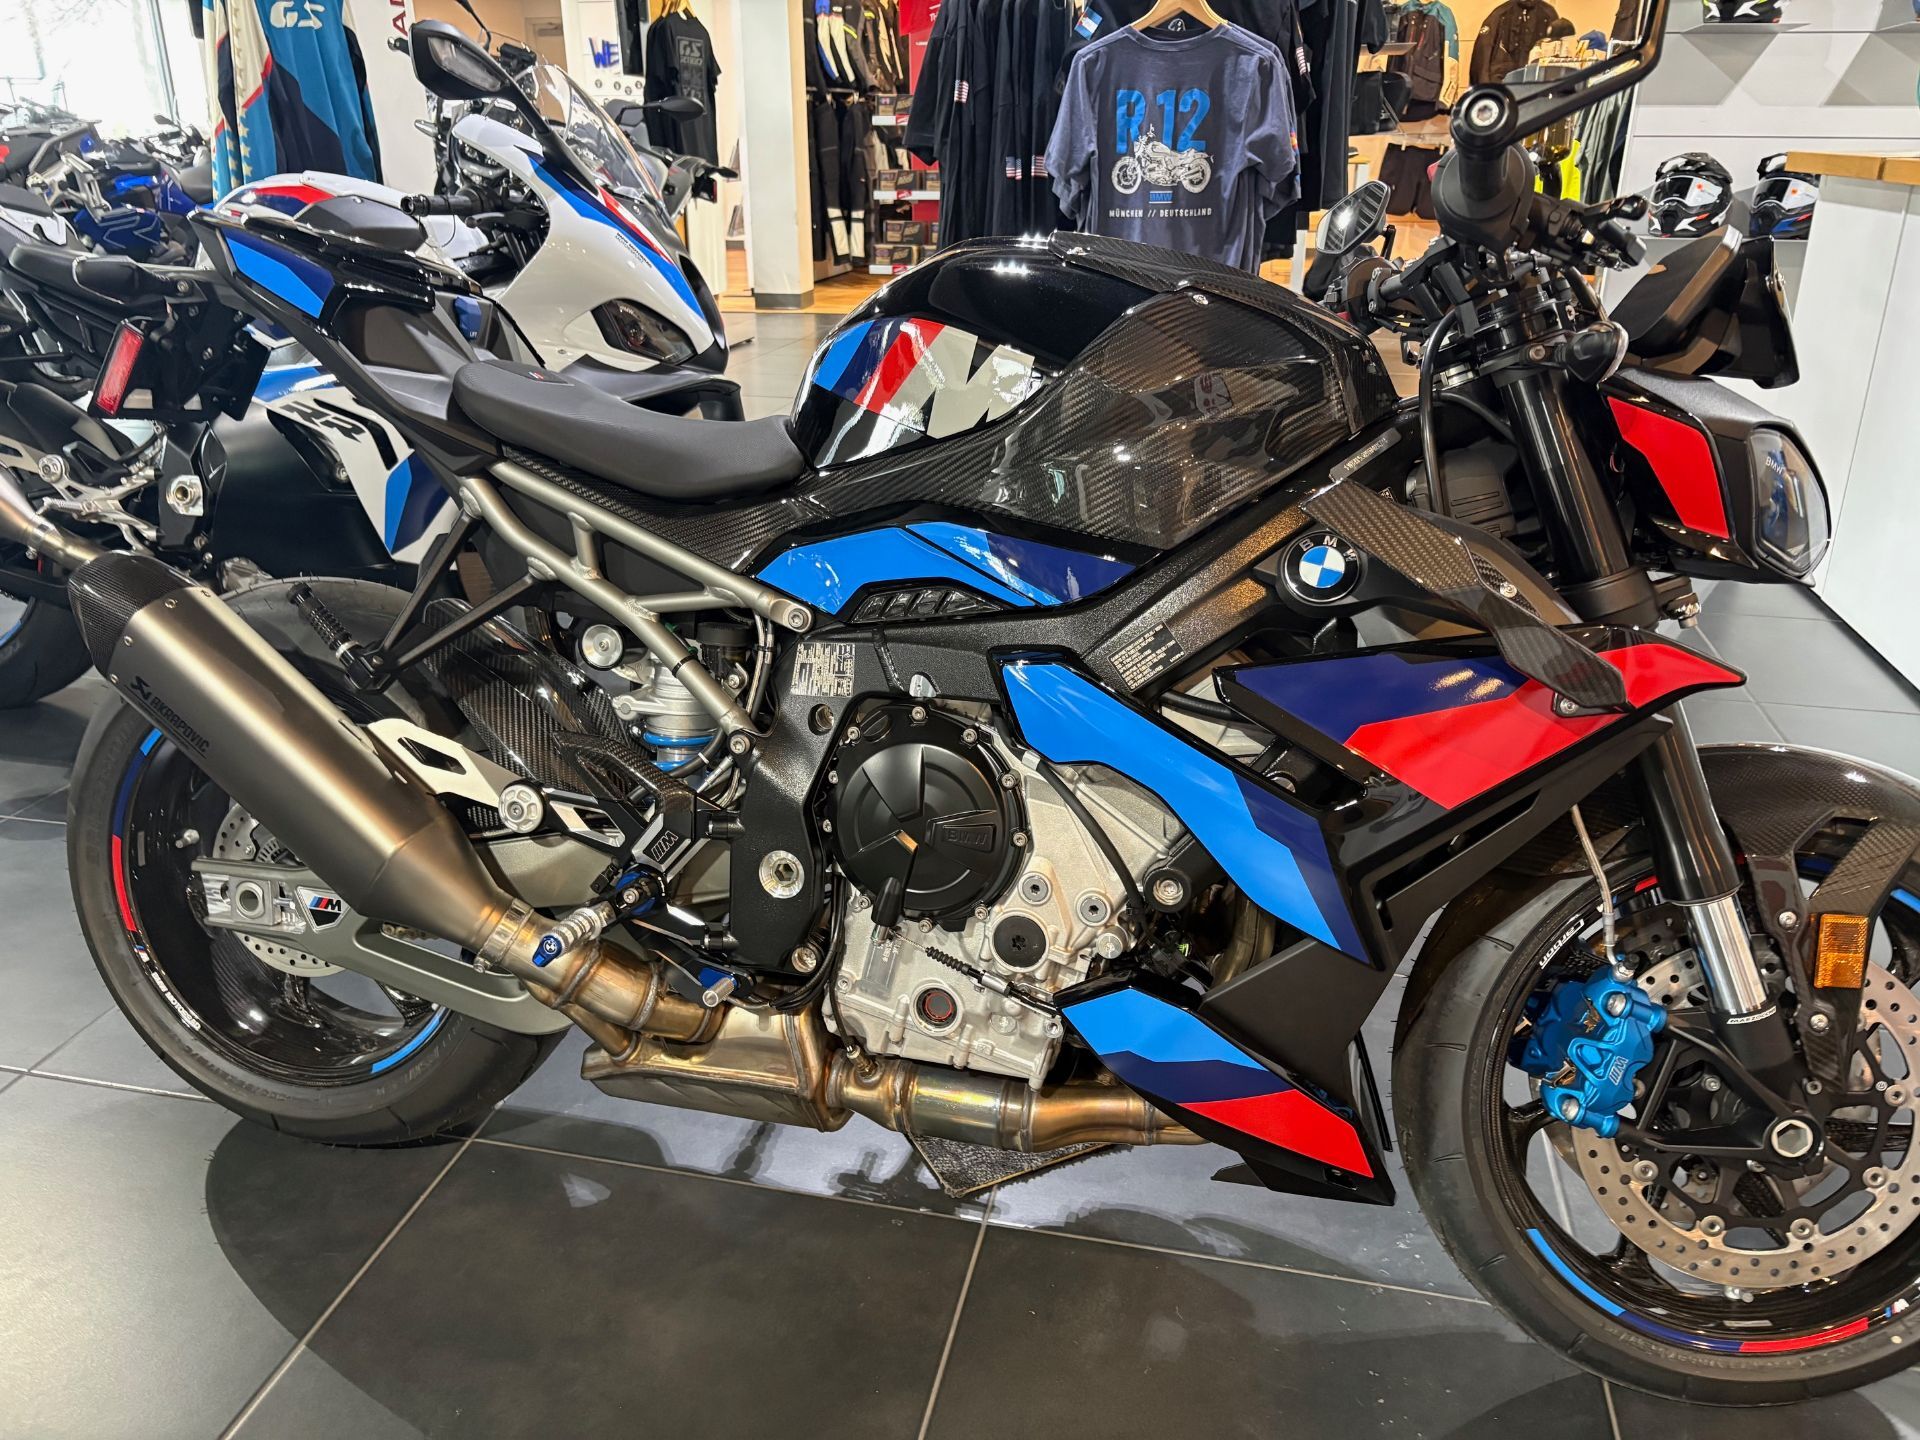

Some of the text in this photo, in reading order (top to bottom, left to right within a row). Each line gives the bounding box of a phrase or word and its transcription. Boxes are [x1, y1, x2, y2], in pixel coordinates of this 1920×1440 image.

[270, 1, 325, 29] GS
[1116, 88, 1210, 155] R 12
[1109, 207, 1143, 218] MÜNCHEN
[1160, 207, 1212, 217] DEUTSCHLAND
[1765, 456, 1785, 475] BMW
[1299, 535, 1357, 562] BMW
[1539, 918, 1585, 970] Carbon
